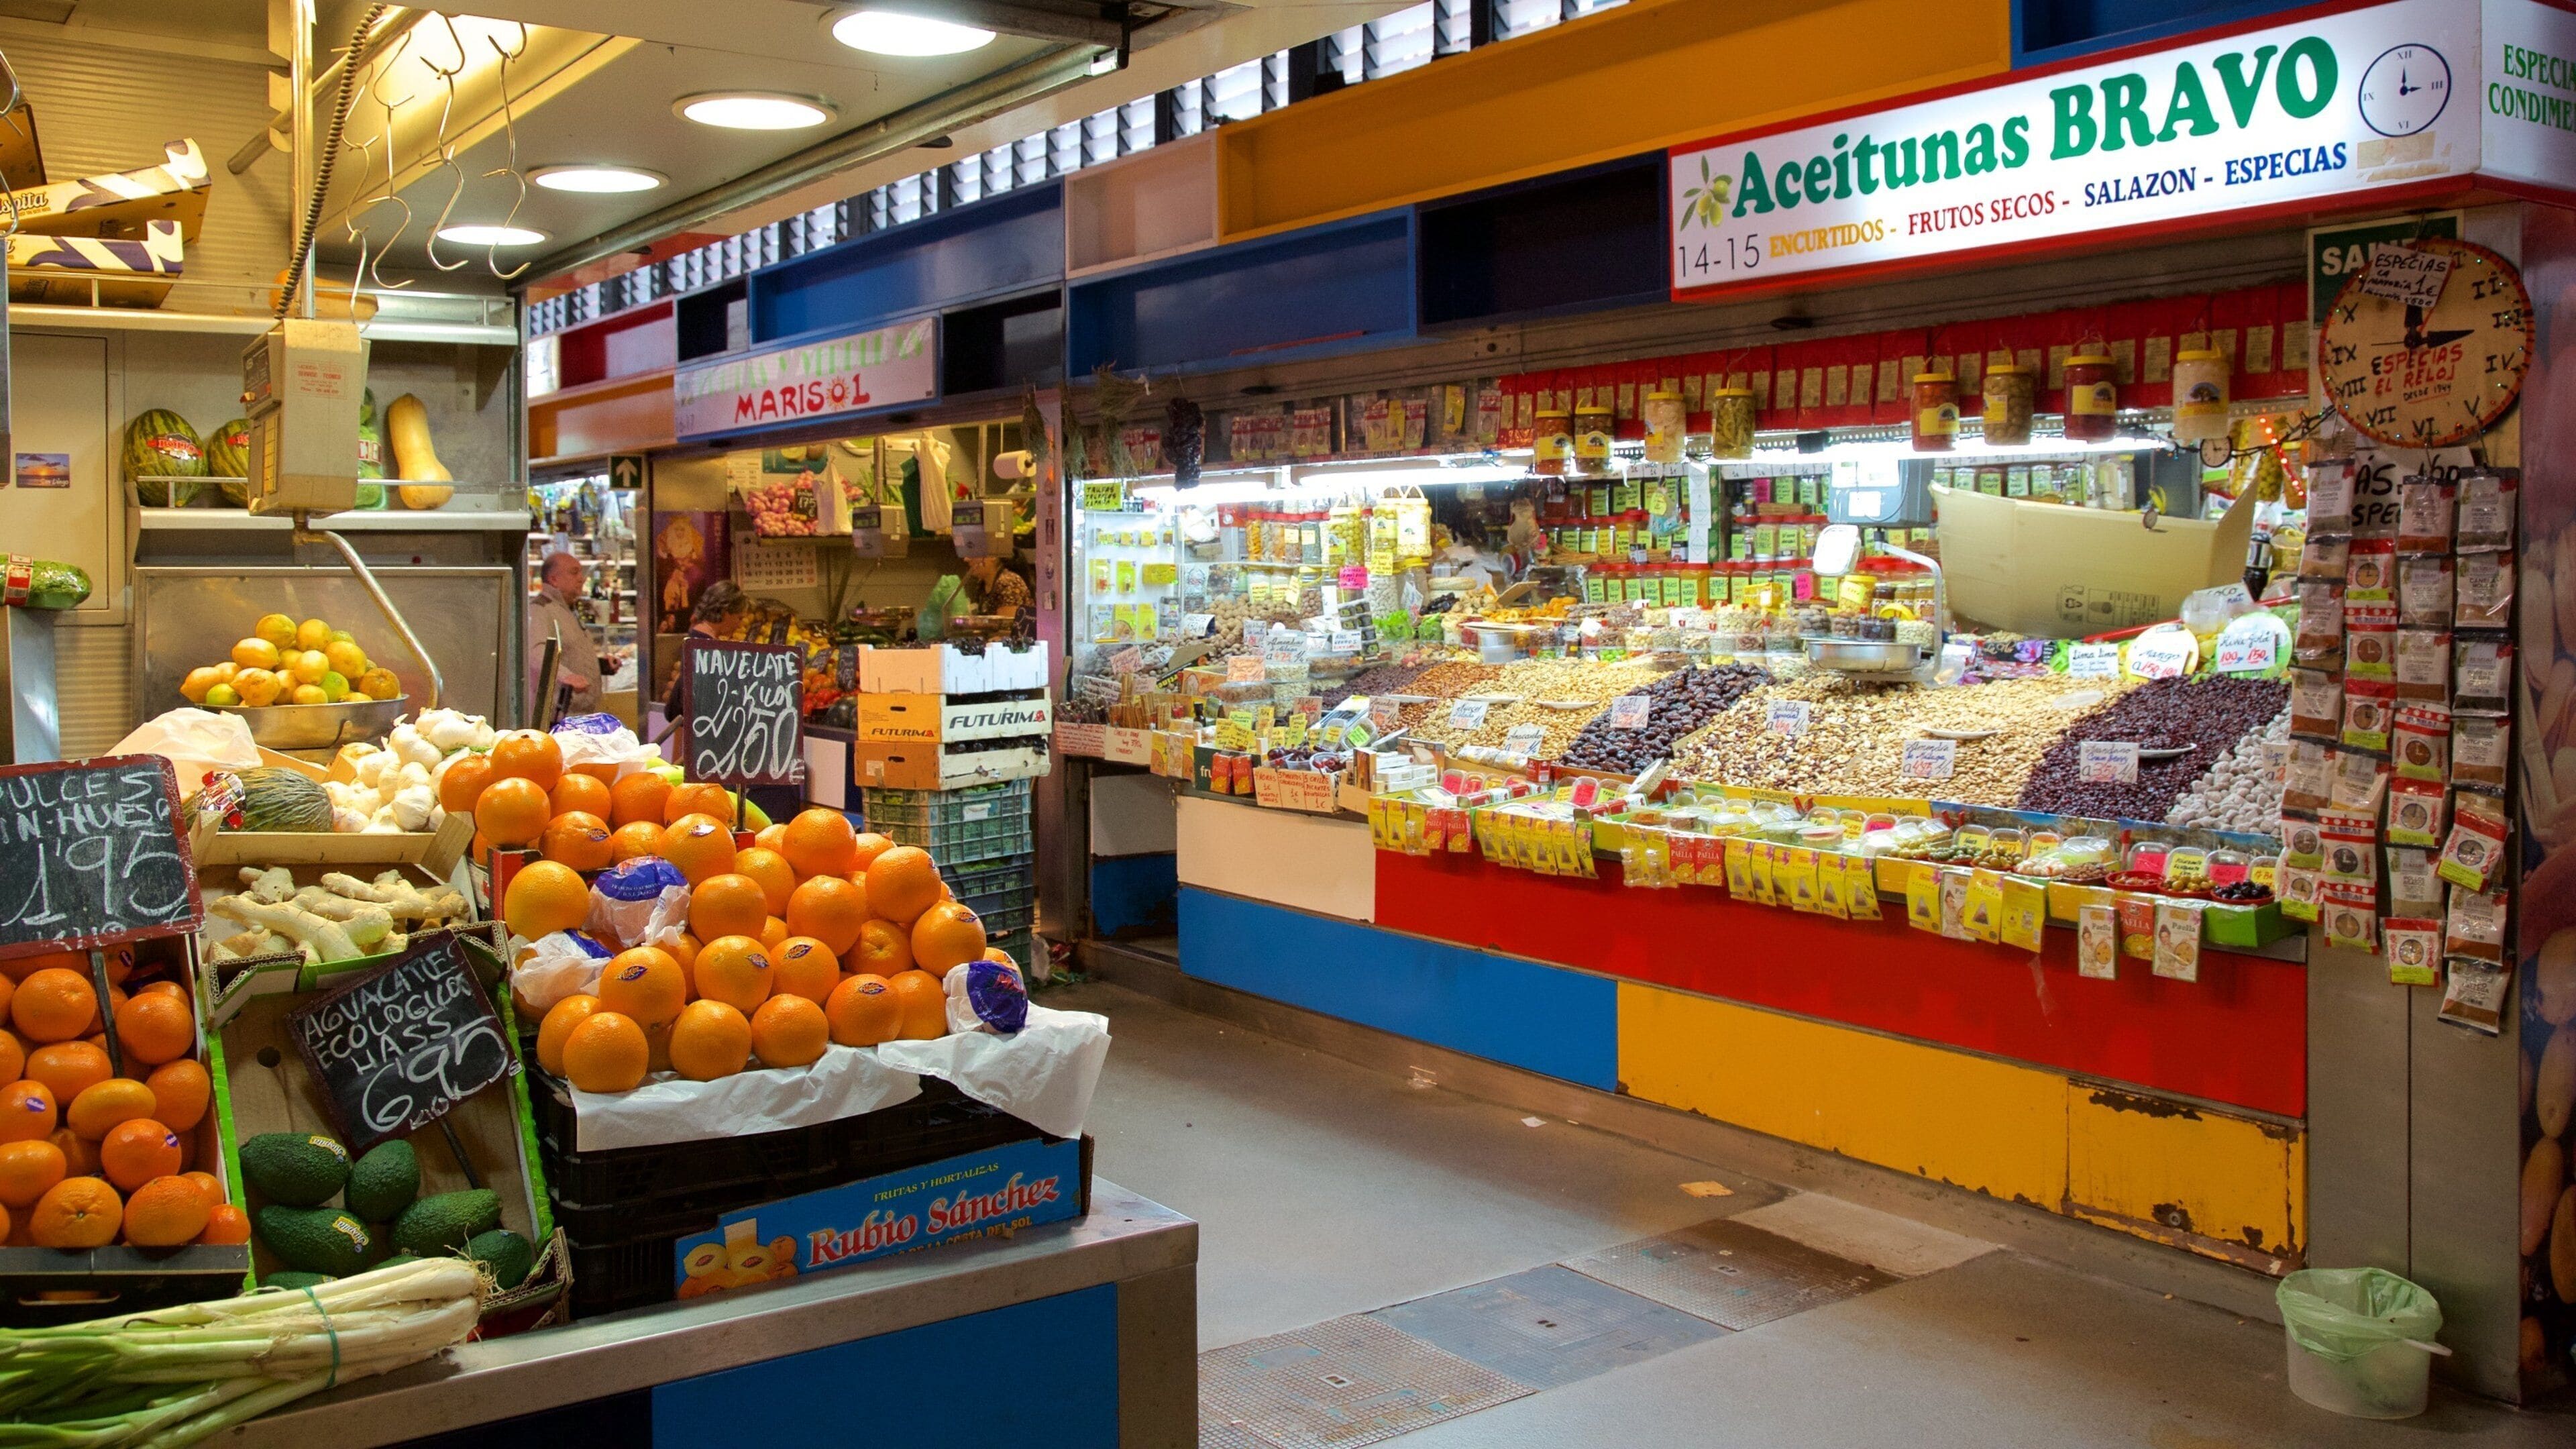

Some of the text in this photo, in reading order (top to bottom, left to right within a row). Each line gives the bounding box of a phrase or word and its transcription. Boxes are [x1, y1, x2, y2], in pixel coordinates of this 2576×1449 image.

[2396, 50, 2412, 61] XII
[2363, 92, 2375, 101] IX
[2431, 80, 2443, 90] III
[1731, 36, 2339, 218] Aceitunas BRAVO
[2398, 121, 2409, 129] VI
[1769, 219, 1884, 258] ENCURTIDOS
[1909, 203, 1984, 235] FRUTOS
[1990, 190, 2055, 221] SECOS
[2084, 167, 2196, 207] SALAZON
[2225, 142, 2347, 186] ESPECIAS
[1678, 233, 1760, 277] 14-15
[2371, 343, 2463, 376] ESPECIAS
[2375, 364, 2455, 397] EL RELOJ
[735, 373, 871, 423] MARISOL
[2353, 455, 2396, 496] ÁS
[696, 649, 800, 682] NAVELATE
[948, 709, 1046, 729] FUTURIMA
[871, 728, 934, 737] FUTURIMA
[0, 771, 166, 809] ULCES
[1670, 849, 1693, 859] PAELLA
[1697, 850, 1719, 860] PAELLA
[2092, 922, 2111, 932] Paella
[2171, 922, 2196, 933] Paella
[873, 1162, 1000, 1203] FRUTAS Y HORTALIZAS
[806, 1171, 1061, 1267] Rubio Sánchez
[1011, 1216, 1033, 1230] SOL
